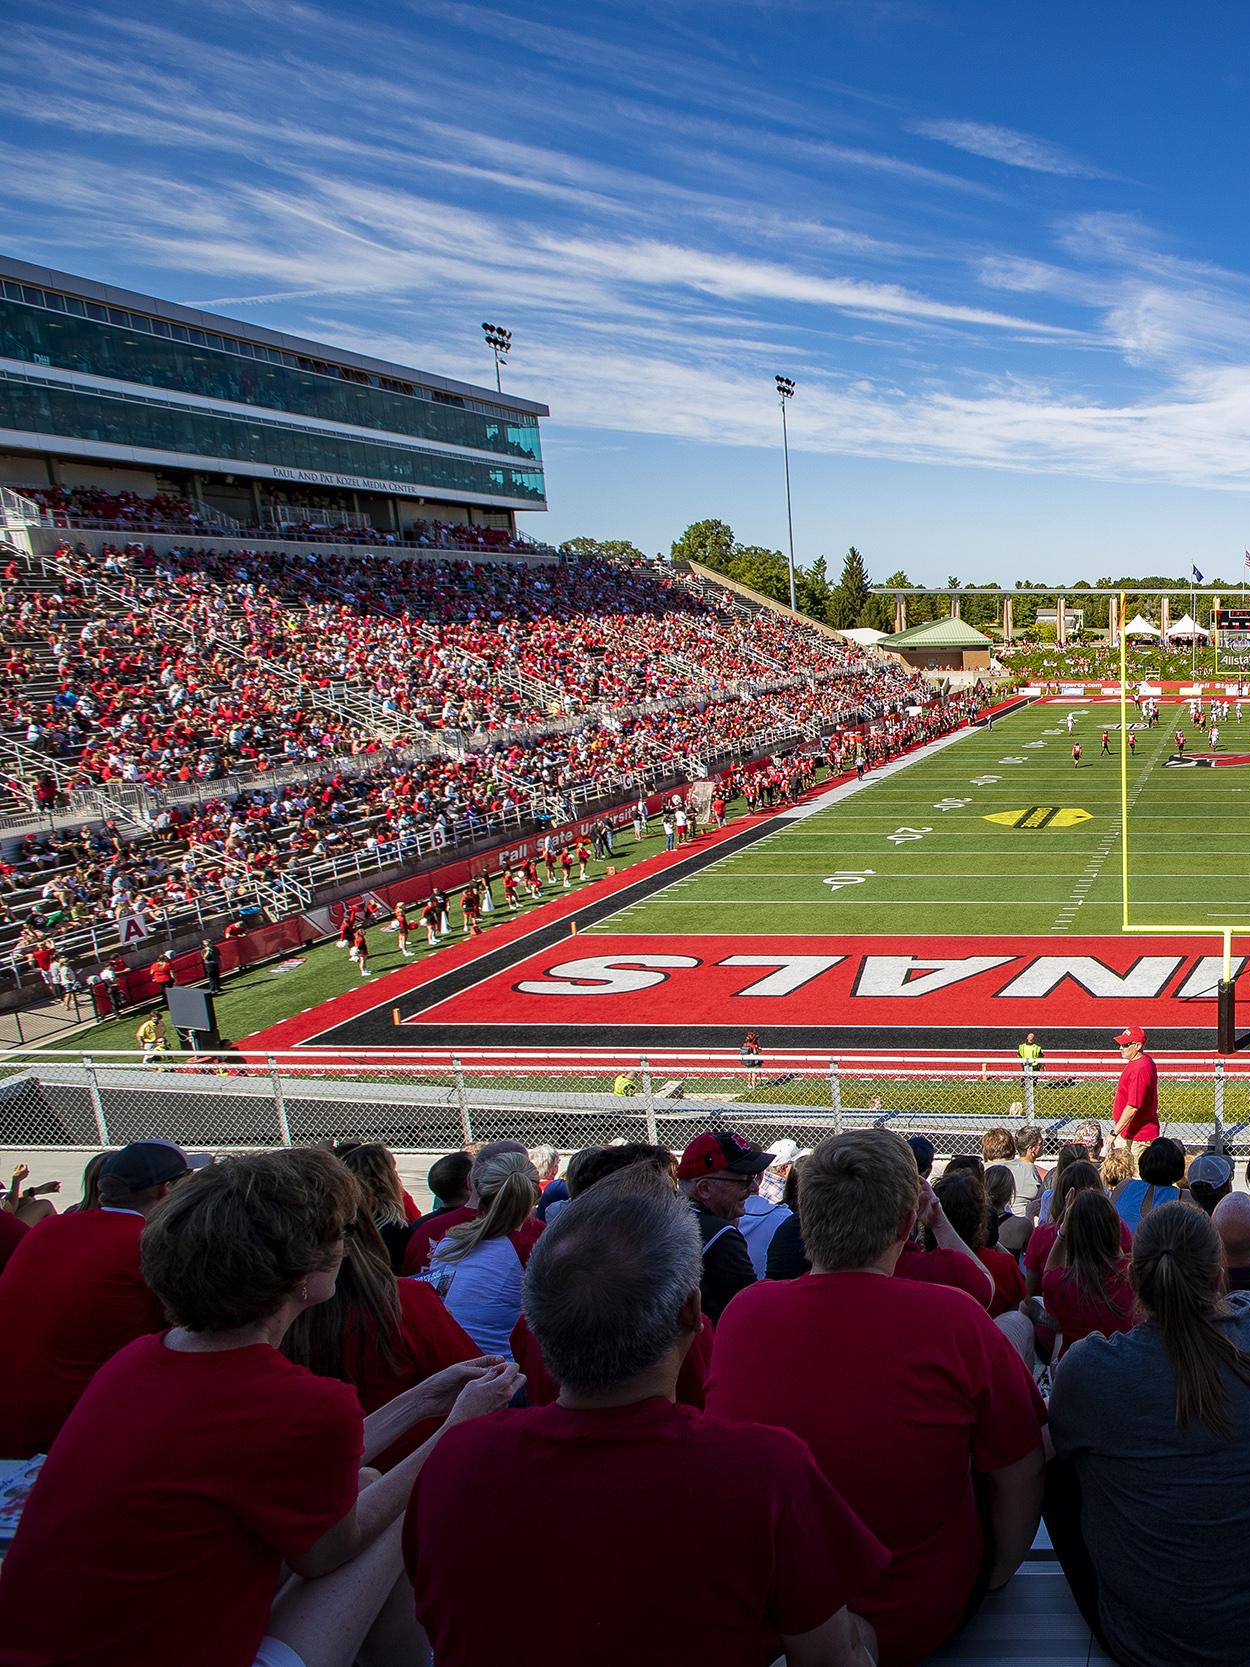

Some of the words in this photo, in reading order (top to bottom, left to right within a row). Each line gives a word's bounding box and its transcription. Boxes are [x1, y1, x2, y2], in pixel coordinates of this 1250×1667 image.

[272, 467, 295, 479] PAUL
[298, 471, 318, 482] AND
[320, 474, 334, 484] PAT
[336, 476, 360, 488] KOZEL
[362, 479, 387, 491] MEDIA
[389, 482, 417, 494] CENTER
[536, 831, 574, 853] Sate
[886, 826, 934, 841] 20
[822, 868, 877, 885] 10
[124, 919, 146, 942] A
